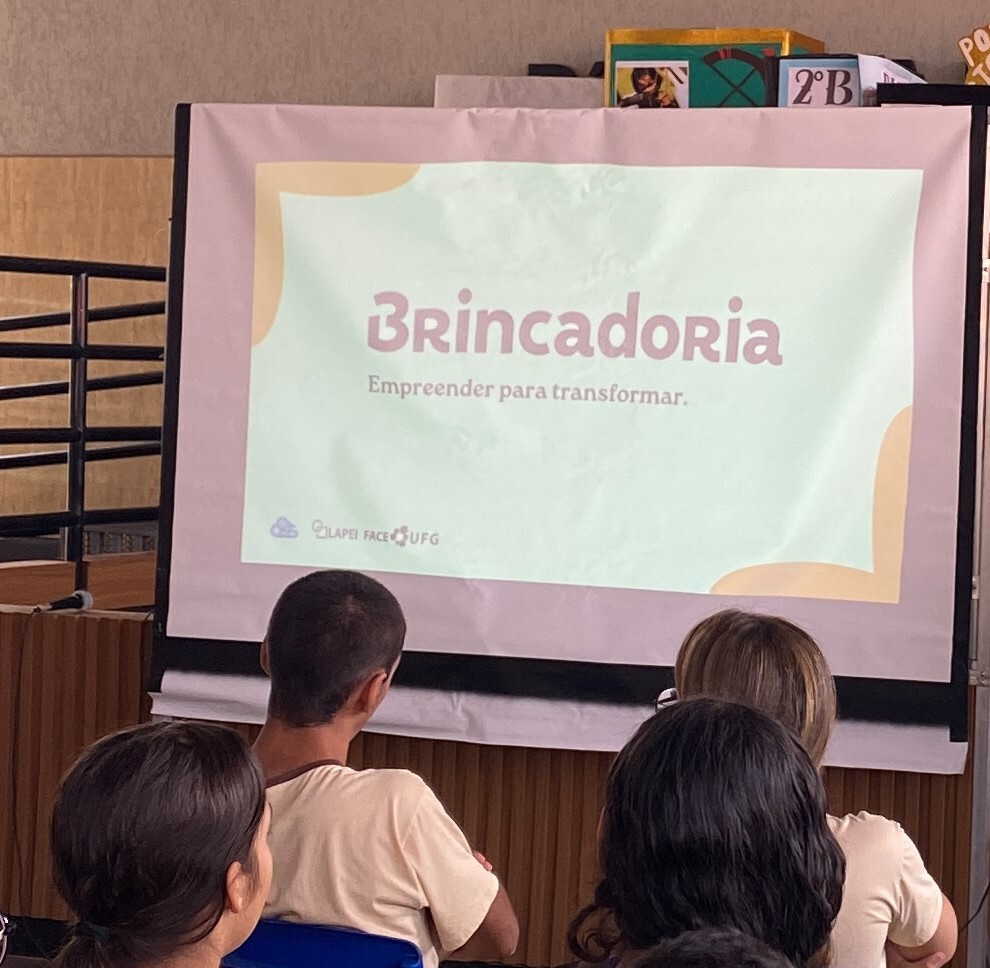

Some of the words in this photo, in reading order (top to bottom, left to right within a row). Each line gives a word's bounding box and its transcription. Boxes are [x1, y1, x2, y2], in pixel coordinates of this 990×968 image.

[368, 374, 495, 400] Empreender
[499, 384, 548, 403] para
[552, 383, 689, 406] transformar.
[328, 527, 359, 540] LAPEI
[363, 529, 389, 543] FACE
[409, 531, 440, 546] UFG
